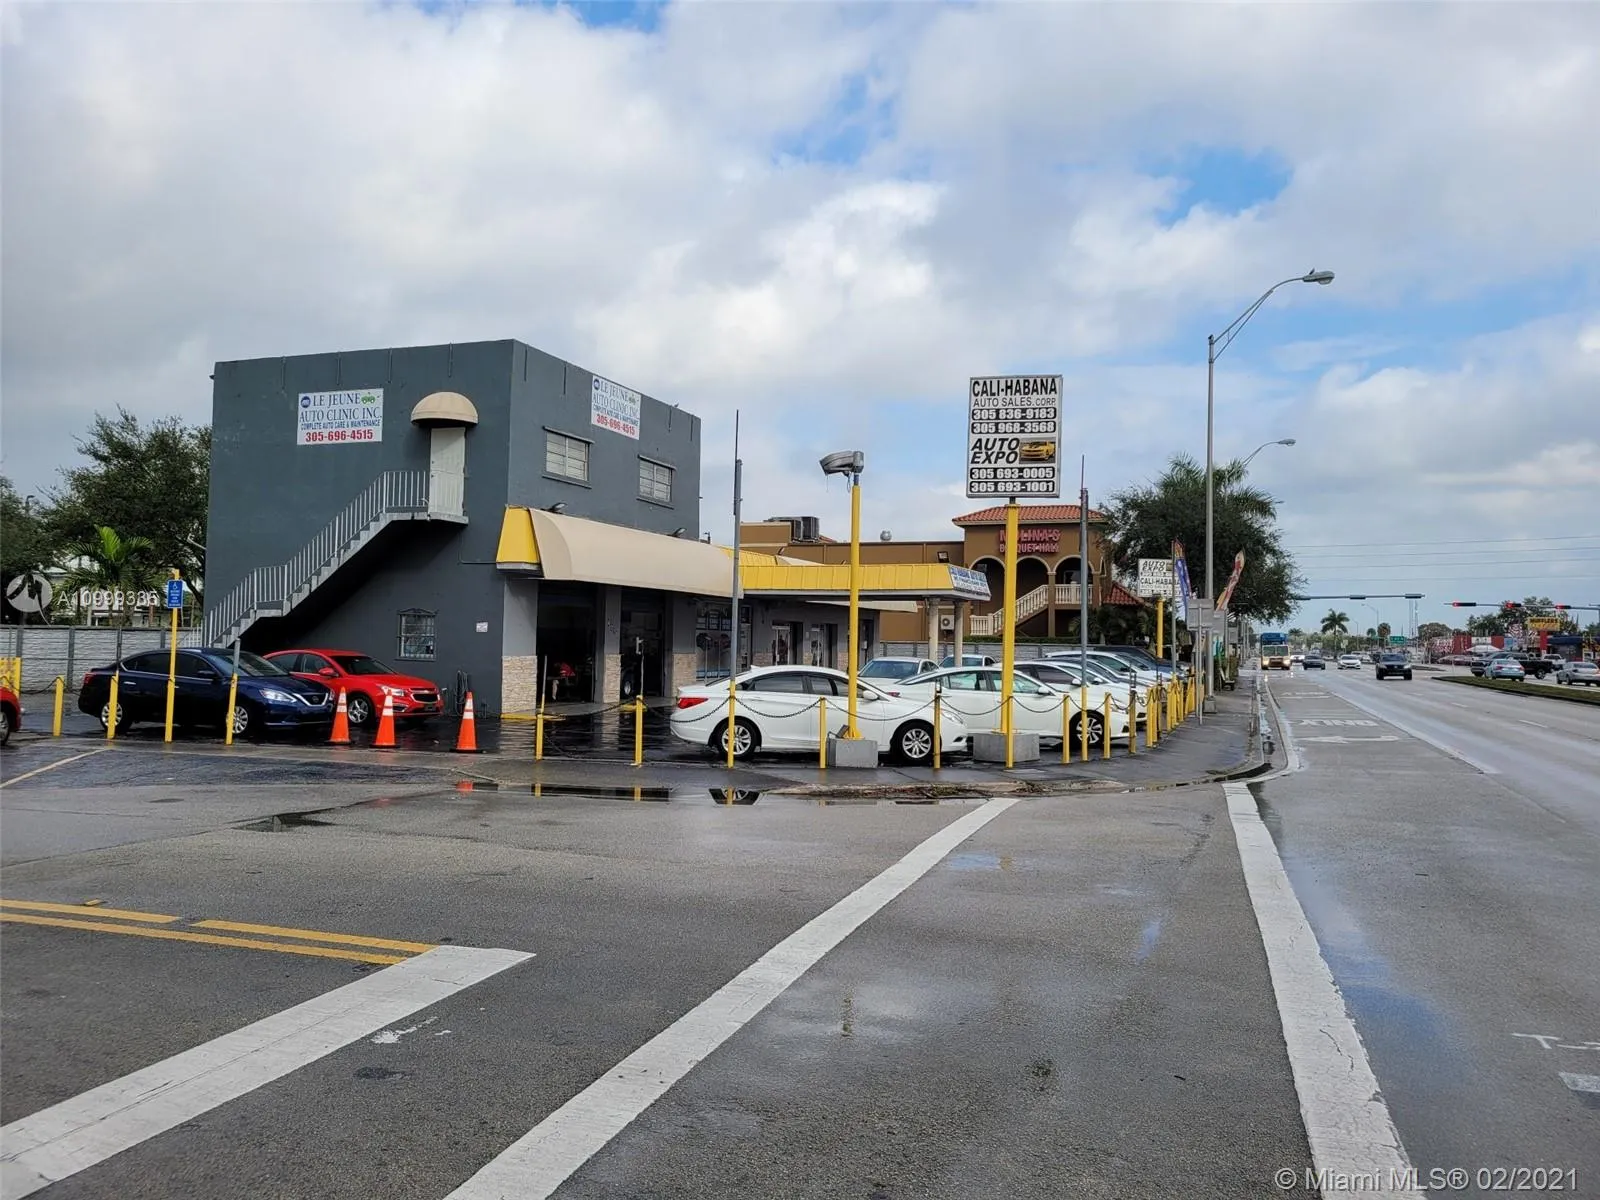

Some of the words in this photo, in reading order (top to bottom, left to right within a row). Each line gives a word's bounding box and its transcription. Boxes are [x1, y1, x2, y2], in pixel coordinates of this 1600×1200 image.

[972, 378, 1057, 396] CALI-HABANA
[313, 395, 325, 407] LE
[327, 393, 360, 408] JEUNE
[974, 398, 998, 407] AUTO
[300, 409, 324, 422] AUTO
[326, 408, 360, 421] CLINIC
[362, 407, 382, 419] INC.
[974, 409, 996, 419] 305
[999, 408, 1054, 419] 836-9183
[301, 422, 322, 430] COMPLETE
[351, 420, 380, 428] MAINTENANCE
[973, 423, 996, 433] 305
[305, 429, 373, 442] 305-696-4515
[971, 438, 1020, 451] AUTO
[970, 451, 1018, 464] EXPO
[972, 469, 994, 479] 305
[971, 482, 994, 492] 305
[998, 482, 1053, 492] 693-1001
[1000, 529, 1060, 541] MLINA'S
[1000, 543, 1036, 553] BQUET
